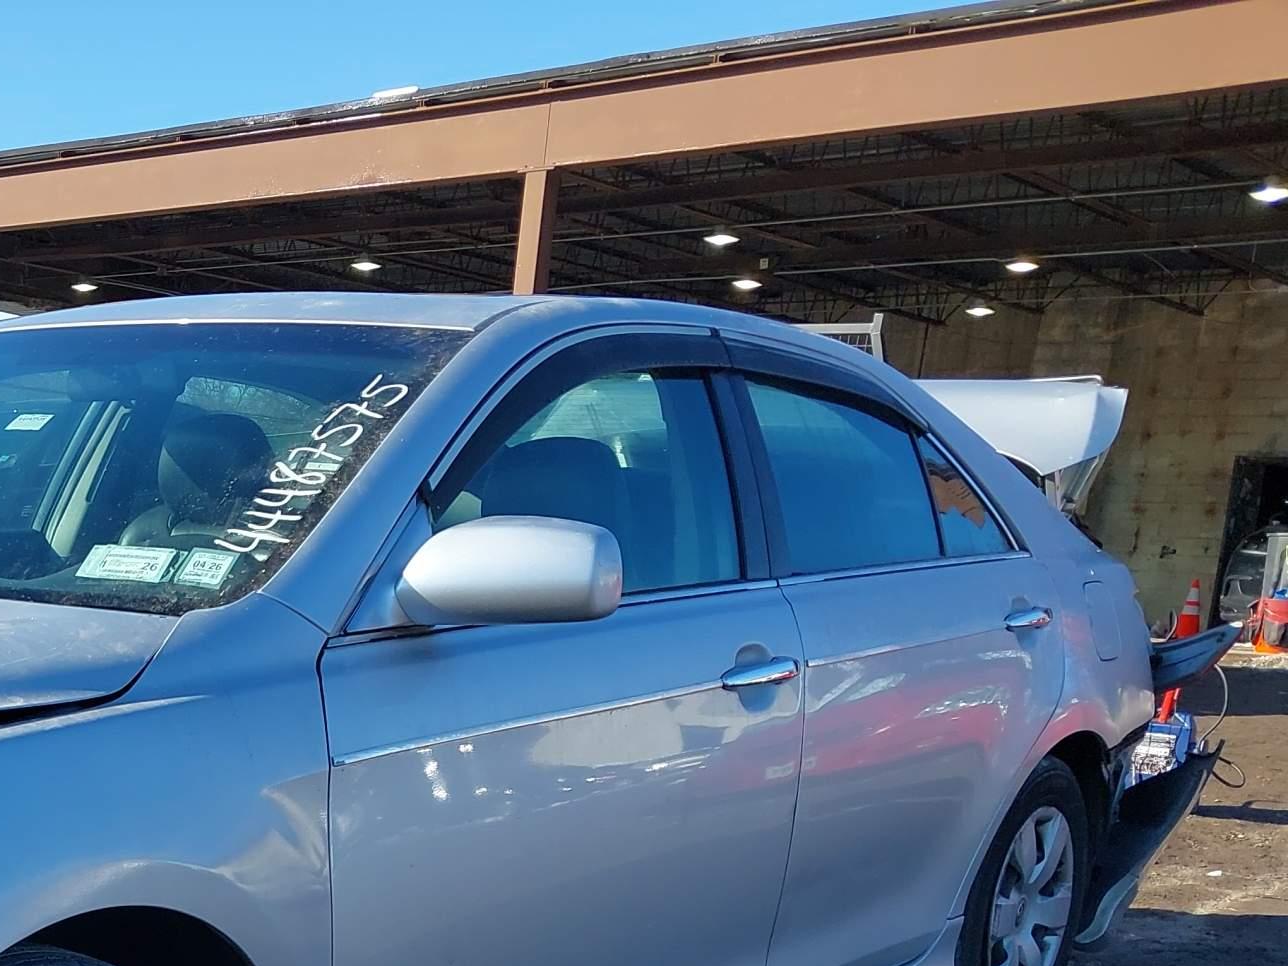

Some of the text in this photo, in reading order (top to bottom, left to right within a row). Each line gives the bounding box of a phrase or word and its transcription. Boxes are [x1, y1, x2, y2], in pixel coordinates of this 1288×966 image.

[214, 373, 409, 553] 44487575
[141, 561, 160, 572] 26
[192, 559, 224, 571] 04 26
